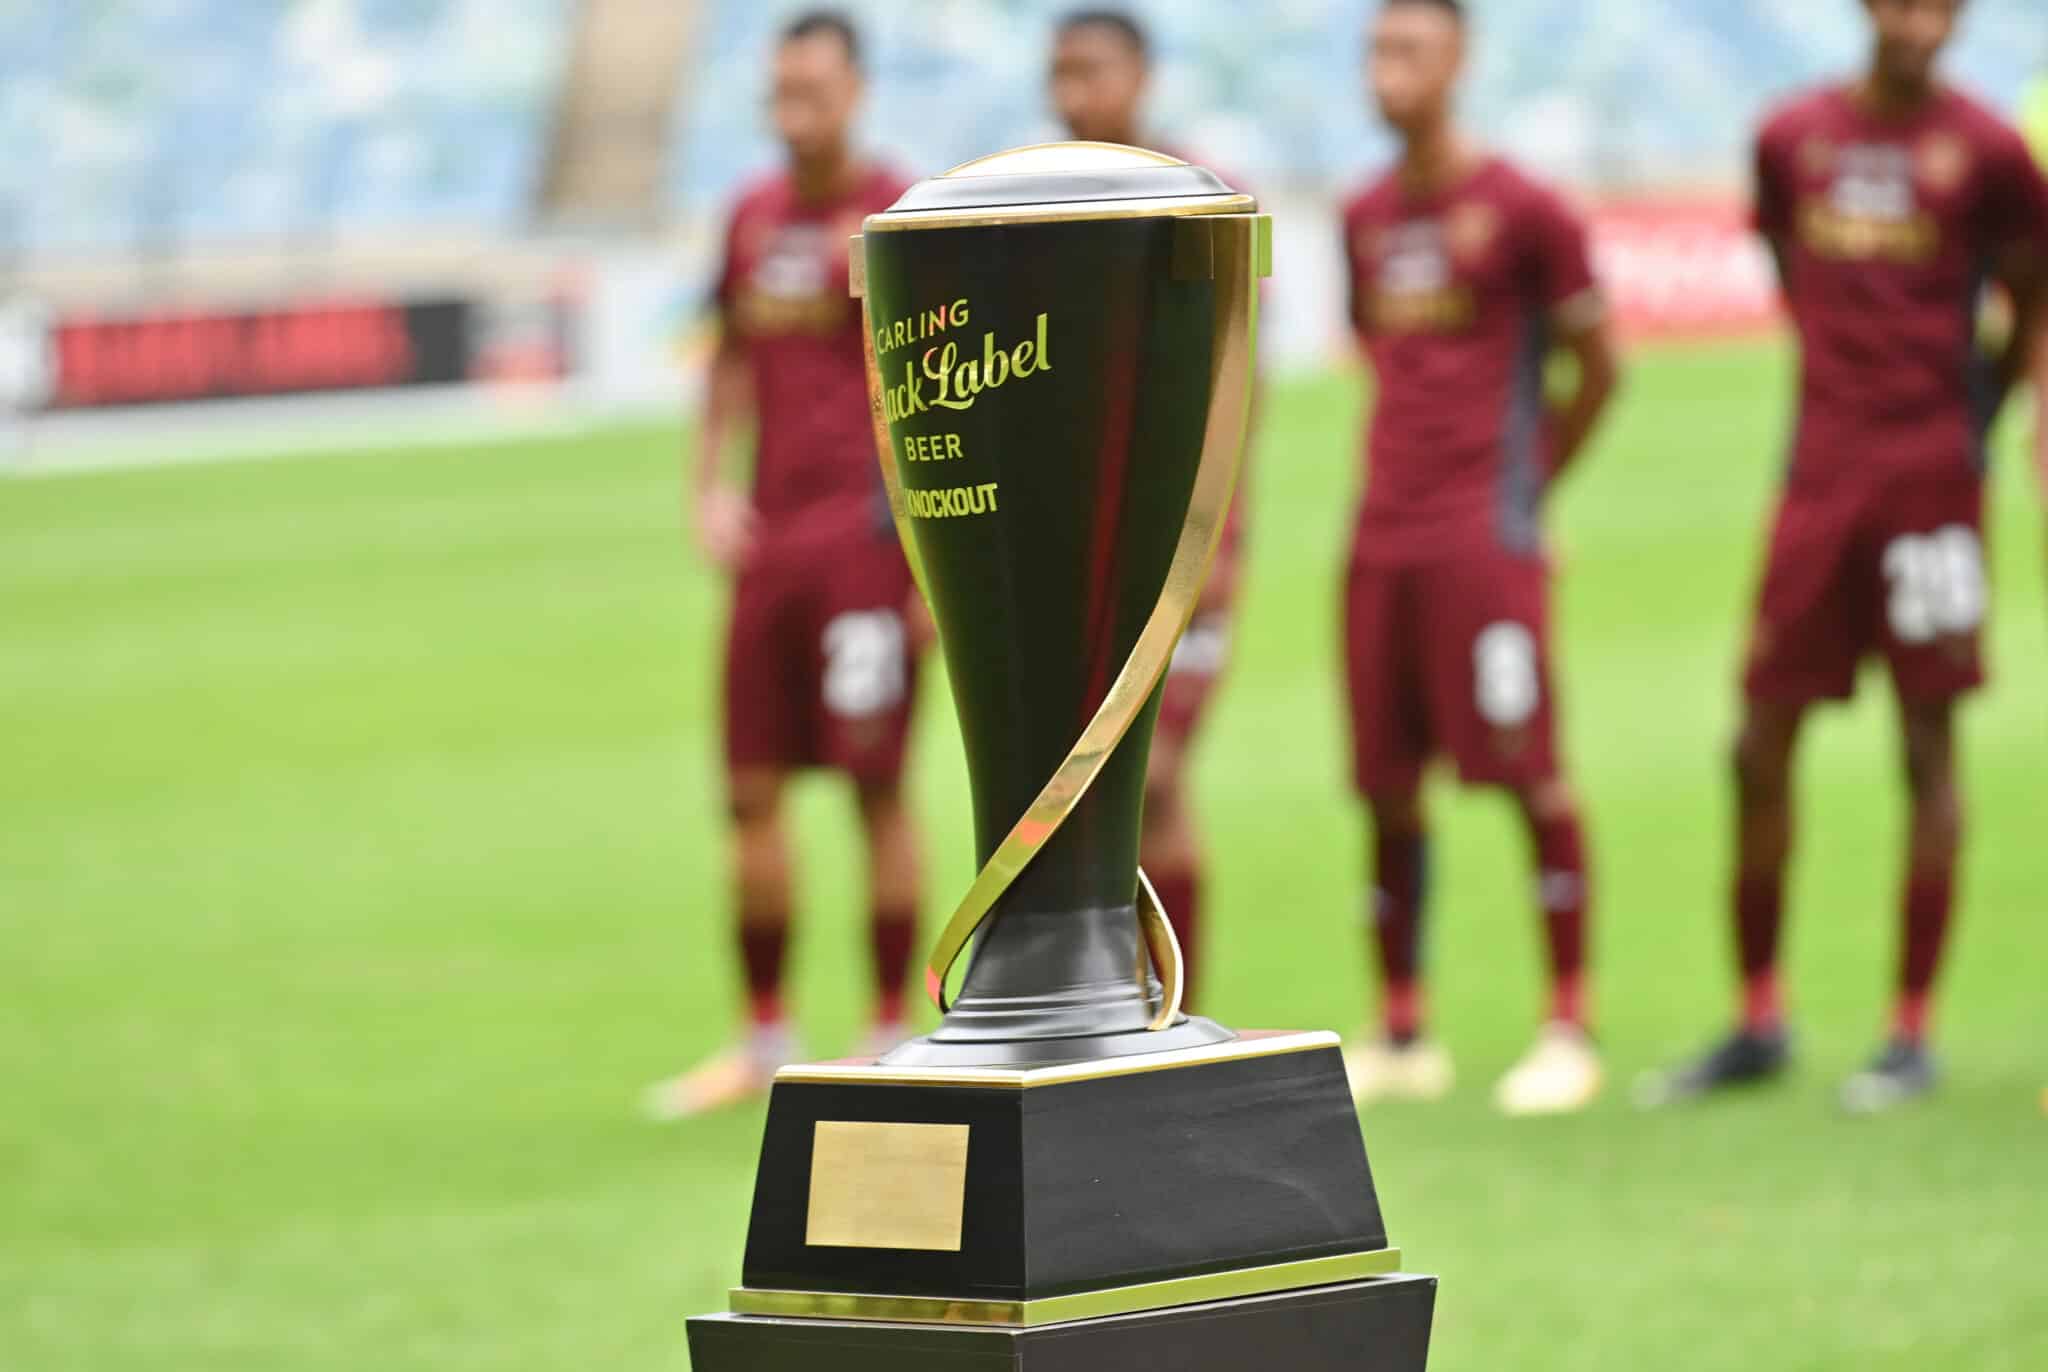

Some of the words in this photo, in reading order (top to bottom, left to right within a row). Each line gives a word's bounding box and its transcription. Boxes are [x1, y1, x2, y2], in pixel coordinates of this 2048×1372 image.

[877, 299, 968, 354] CARLING
[885, 361, 928, 424] ack
[922, 313, 1051, 410] Label
[905, 434, 963, 461] BEER
